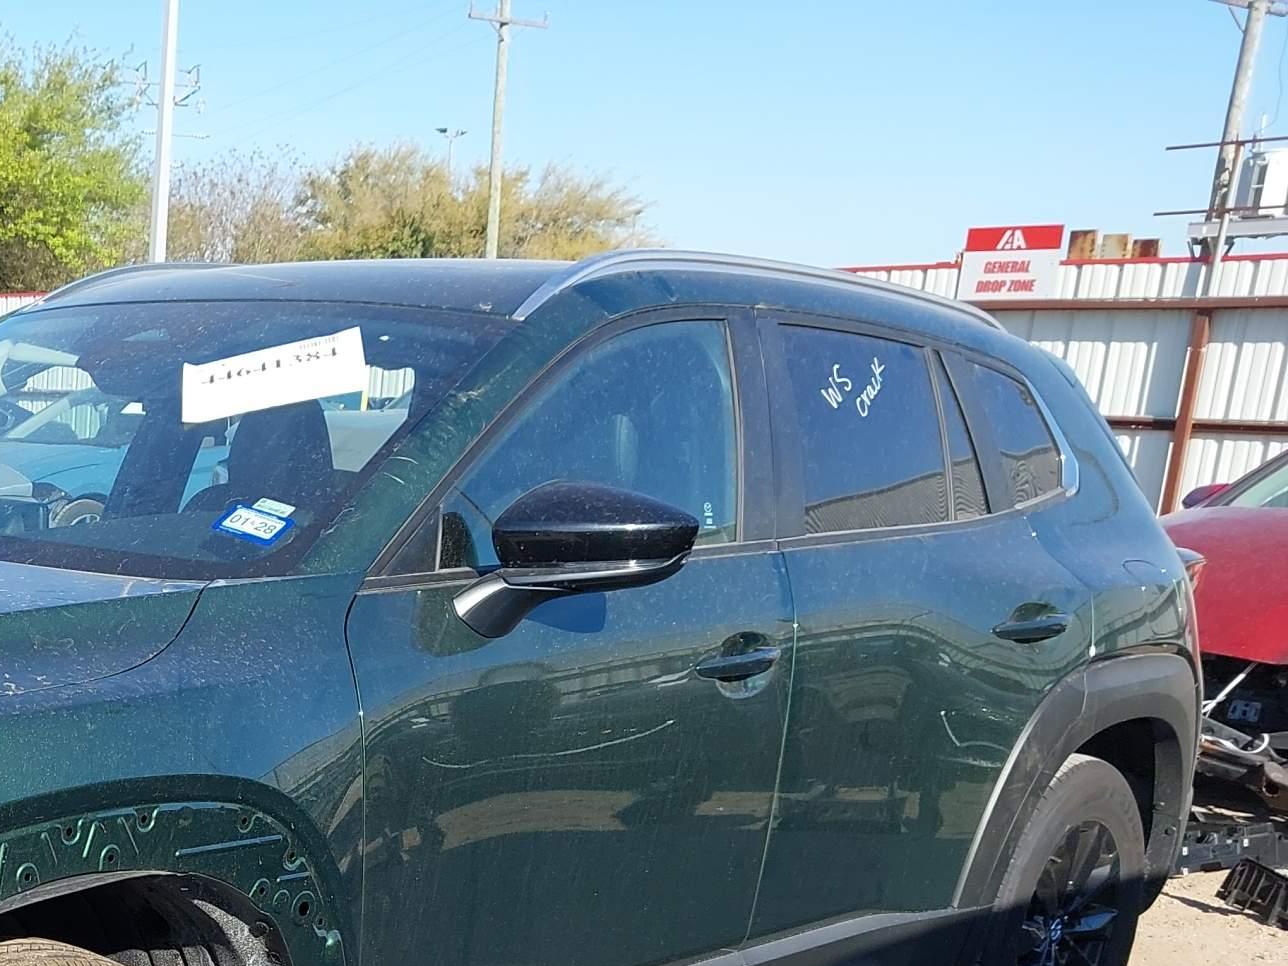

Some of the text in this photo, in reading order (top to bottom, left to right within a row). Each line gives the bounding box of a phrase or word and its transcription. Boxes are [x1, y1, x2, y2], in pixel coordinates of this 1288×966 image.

[983, 260, 1031, 274] GENERAL
[975, 279, 1037, 293] DROP ZONE
[820, 363, 852, 409] WS
[229, 513, 251, 527] 01
[253, 520, 278, 535] 28
